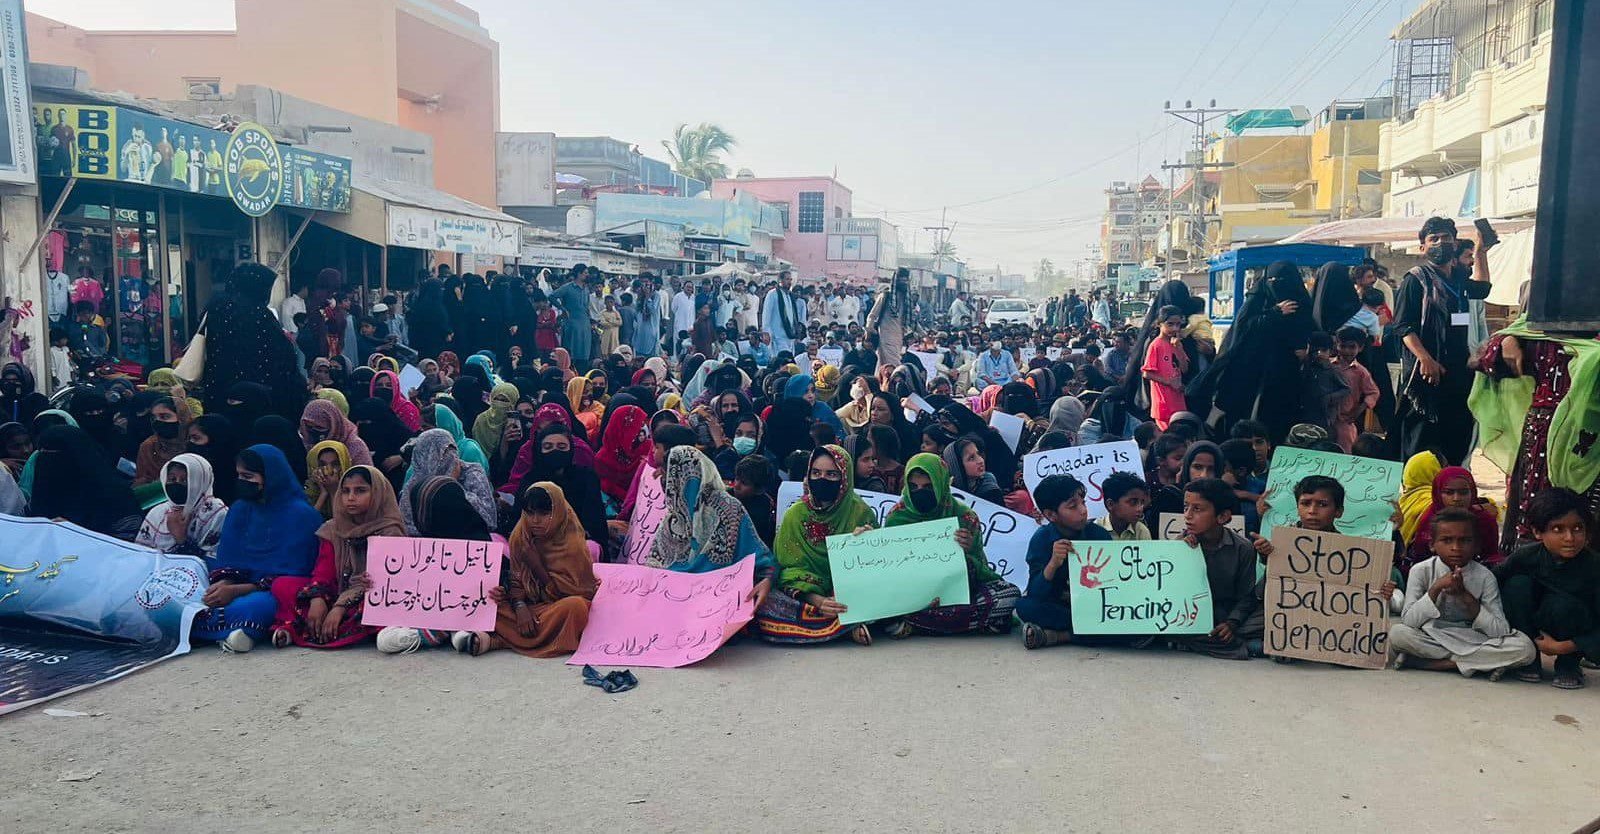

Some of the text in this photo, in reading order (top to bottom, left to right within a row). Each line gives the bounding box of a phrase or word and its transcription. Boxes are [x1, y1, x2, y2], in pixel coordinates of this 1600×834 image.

[78, 109, 110, 175] BOB
[229, 138, 243, 173] BOB
[245, 132, 279, 180] SPORTS
[237, 191, 271, 211] GWADAR
[1036, 449, 1129, 478] Gwadar is
[441, 543, 452, 570] تا
[1119, 546, 1173, 590] Stop
[1288, 536, 1370, 585] Stop
[368, 577, 487, 617] بلوچستان بلوچستان
[1098, 587, 1172, 631] Fencing
[1277, 576, 1384, 618] Baloch
[1270, 612, 1388, 656] genocide
